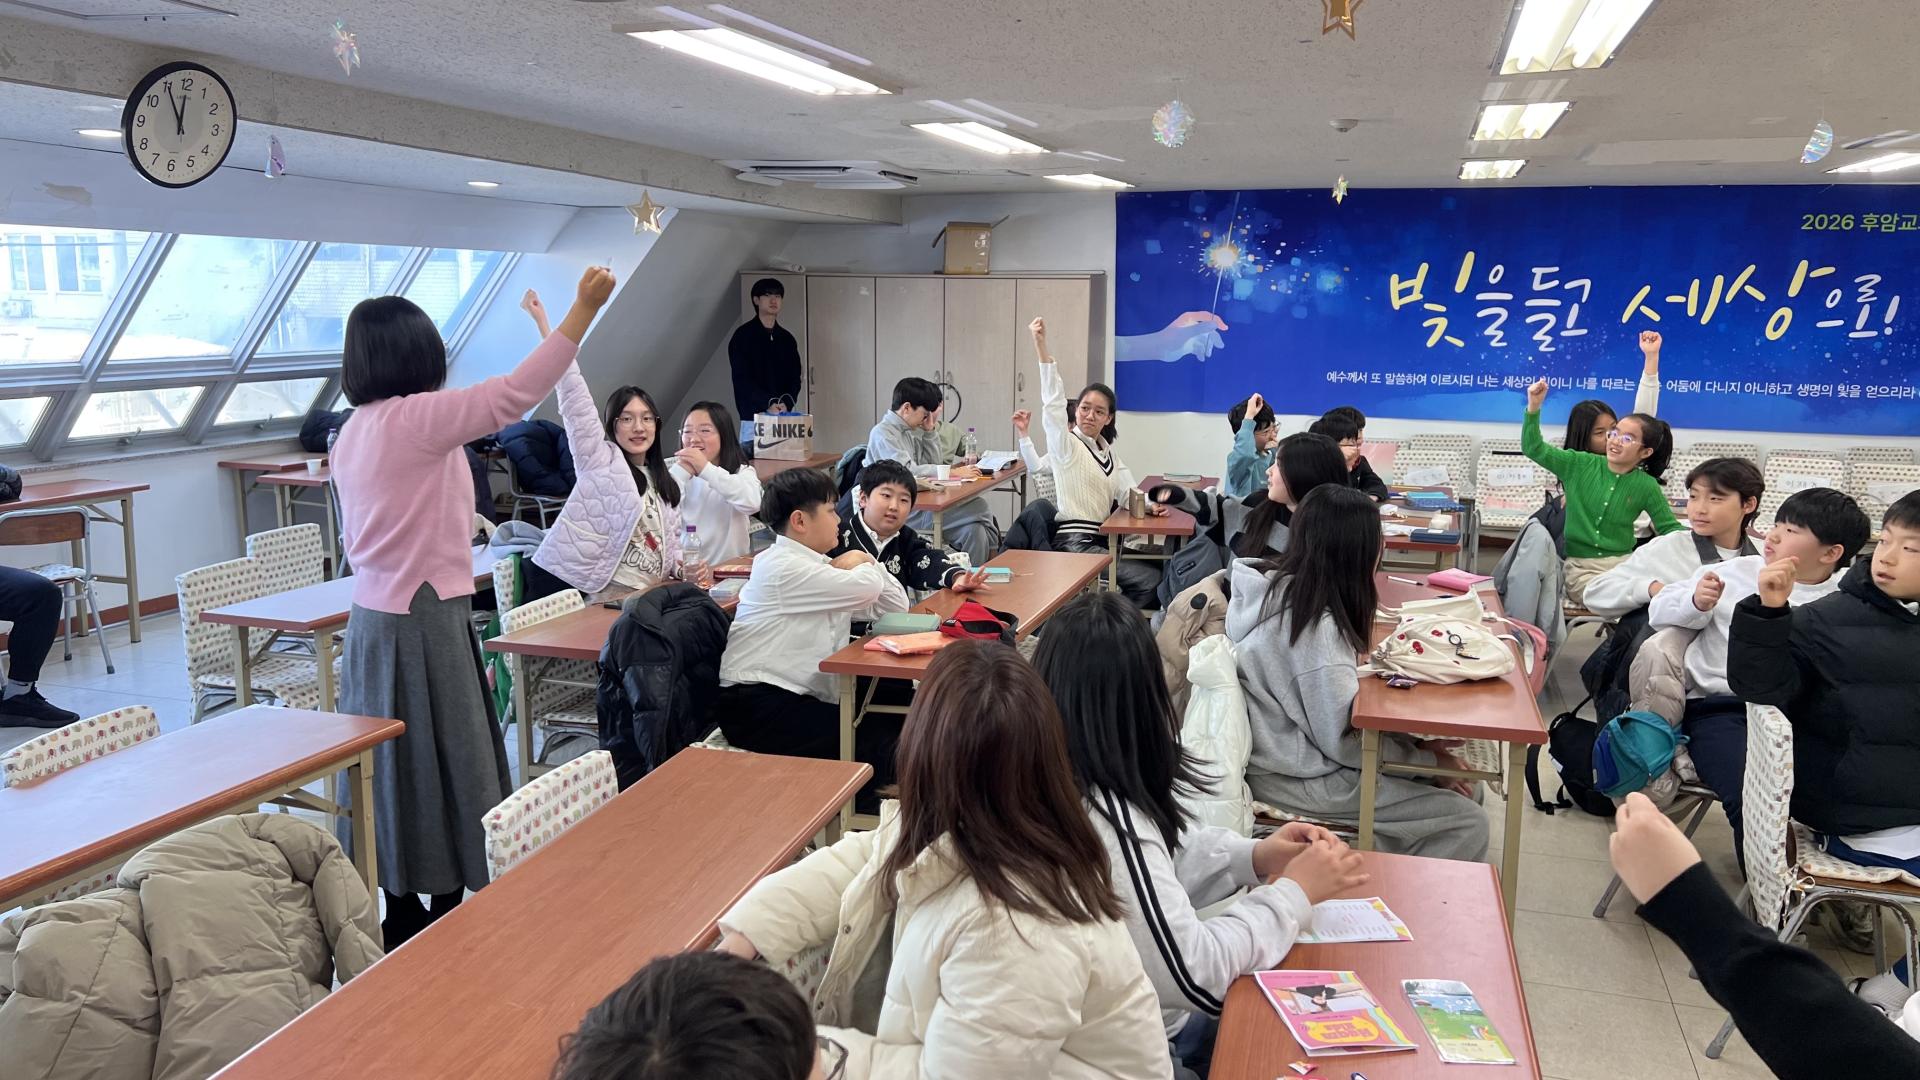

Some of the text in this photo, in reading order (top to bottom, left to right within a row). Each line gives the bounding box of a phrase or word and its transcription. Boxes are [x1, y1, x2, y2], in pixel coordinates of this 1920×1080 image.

[163, 81, 173, 93] 11
[181, 78, 194, 92] 12
[201, 87, 207, 99] 1
[146, 94, 159, 108] 10
[209, 103, 218, 115] 2
[136, 115, 146, 127] 9
[211, 124, 220, 136] 3
[139, 138, 149, 150] 8
[201, 145, 209, 156] 4
[152, 153, 160, 166] 7
[167, 159, 175, 172] 6
[186, 155, 195, 167] 5
[1801, 213, 1920, 232] 2026 후암교
[1621, 259, 1901, 341] 세상으로!
[1326, 371, 1367, 384] 예수께서
[1371, 372, 1381, 384] 또
[1385, 373, 1427, 386] 말씀하여
[1430, 374, 1473, 387] 이르시되
[1477, 375, 1499, 388] 나는
[1576, 377, 1598, 390] 나를
[1601, 377, 1636, 391] 따르는
[1666, 379, 1701, 394] 어둠에
[1705, 380, 1741, 395] 다니지
[1744, 381, 1793, 396] 아니하고
[1796, 383, 1833, 397] 생명의
[1837, 384, 1861, 398] 빛을
[1866, 385, 1916, 399] 얻으리라
[773, 423, 805, 438] NIKE
